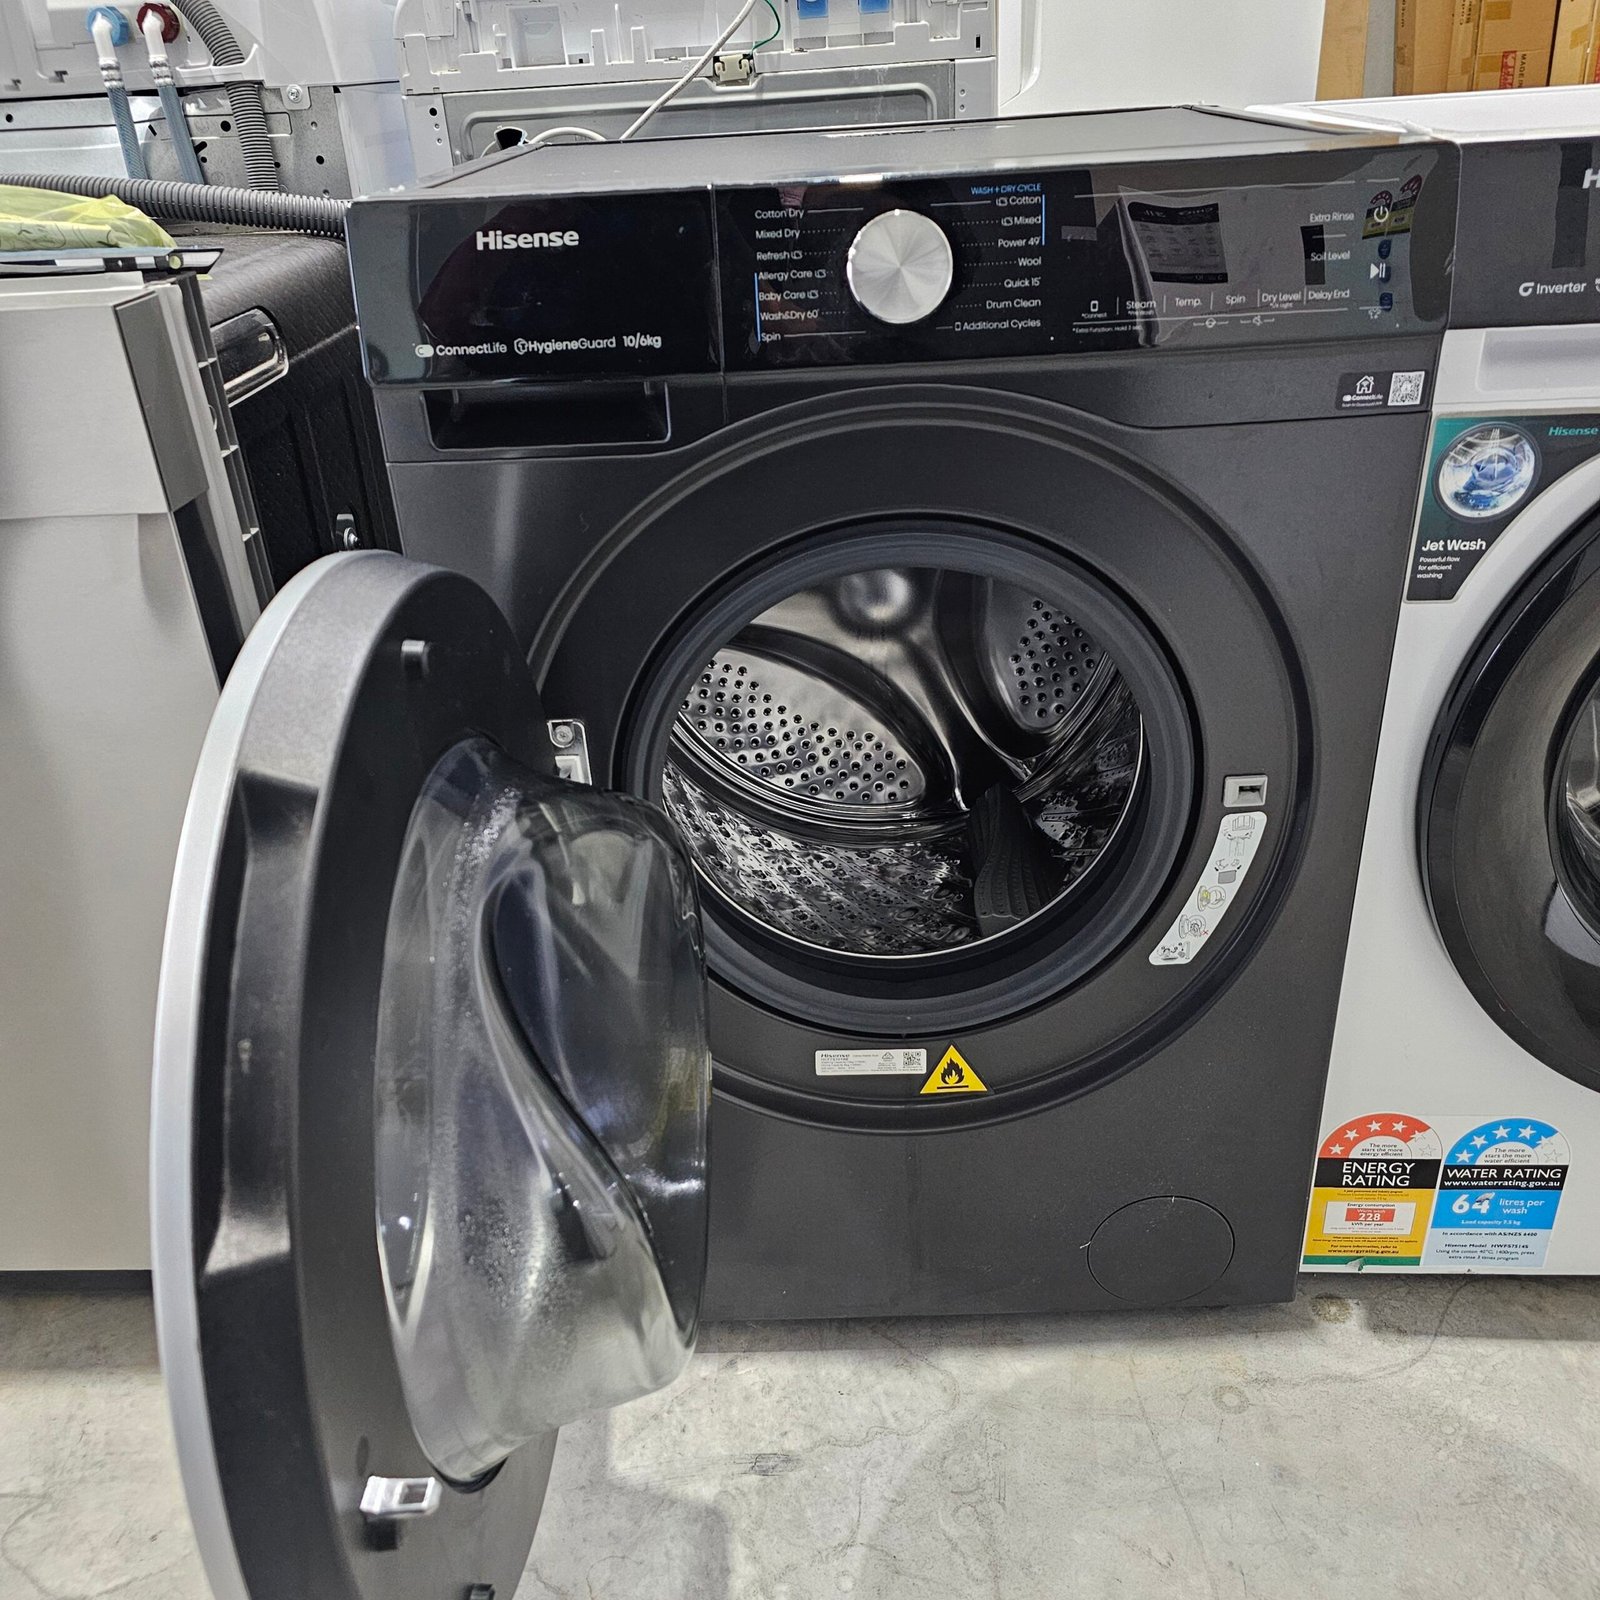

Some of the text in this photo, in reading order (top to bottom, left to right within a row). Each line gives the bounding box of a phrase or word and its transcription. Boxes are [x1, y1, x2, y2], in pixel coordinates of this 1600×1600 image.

[1518, 54, 1527, 78] MADE
[970, 186, 993, 195] WASH
[1001, 184, 1016, 193] DRY
[1017, 184, 1041, 193] CYCLE
[1009, 196, 1041, 205] Cotton
[754, 208, 805, 219] Cotton Dry
[1310, 212, 1355, 223] Extra Rinse
[1014, 216, 1041, 225] Mixed
[755, 228, 800, 239] Mixed Dry
[476, 230, 579, 250] Hisense
[998, 238, 1026, 248] Power
[756, 251, 790, 261] Refresh
[1018, 256, 1042, 266] Wool
[1311, 250, 1350, 262] Soil Level
[759, 270, 813, 281] Allergy Care
[1004, 278, 1030, 288] Quick
[1536, 282, 1587, 295] Inverter
[759, 290, 806, 302] Baby Care
[1226, 294, 1246, 305] Spin
[1262, 291, 1301, 303] Dry Level
[1308, 289, 1350, 300] Delay End
[986, 298, 1041, 310] Drum Clean
[1126, 300, 1157, 309] Steam
[1175, 297, 1202, 308] Temp.
[760, 310, 806, 321] Wash&Dry
[963, 319, 1041, 331] Additional Cycles
[761, 333, 781, 343] Spin
[436, 332, 662, 356] ConnectLife HygieneGuard 10/6kg
[1549, 427, 1599, 436] Hisense
[1422, 538, 1487, 552] Jet Wash
[1342, 1162, 1416, 1174] ENERGY
[1447, 1168, 1562, 1179] WATER RATING
[1342, 1175, 1411, 1187] RATING
[1444, 1180, 1560, 1188] www.waterrating.gov.au
[1452, 1194, 1545, 1215] 64 litres per
[1503, 1206, 1528, 1214] wash
[1358, 1213, 1381, 1221] 228
